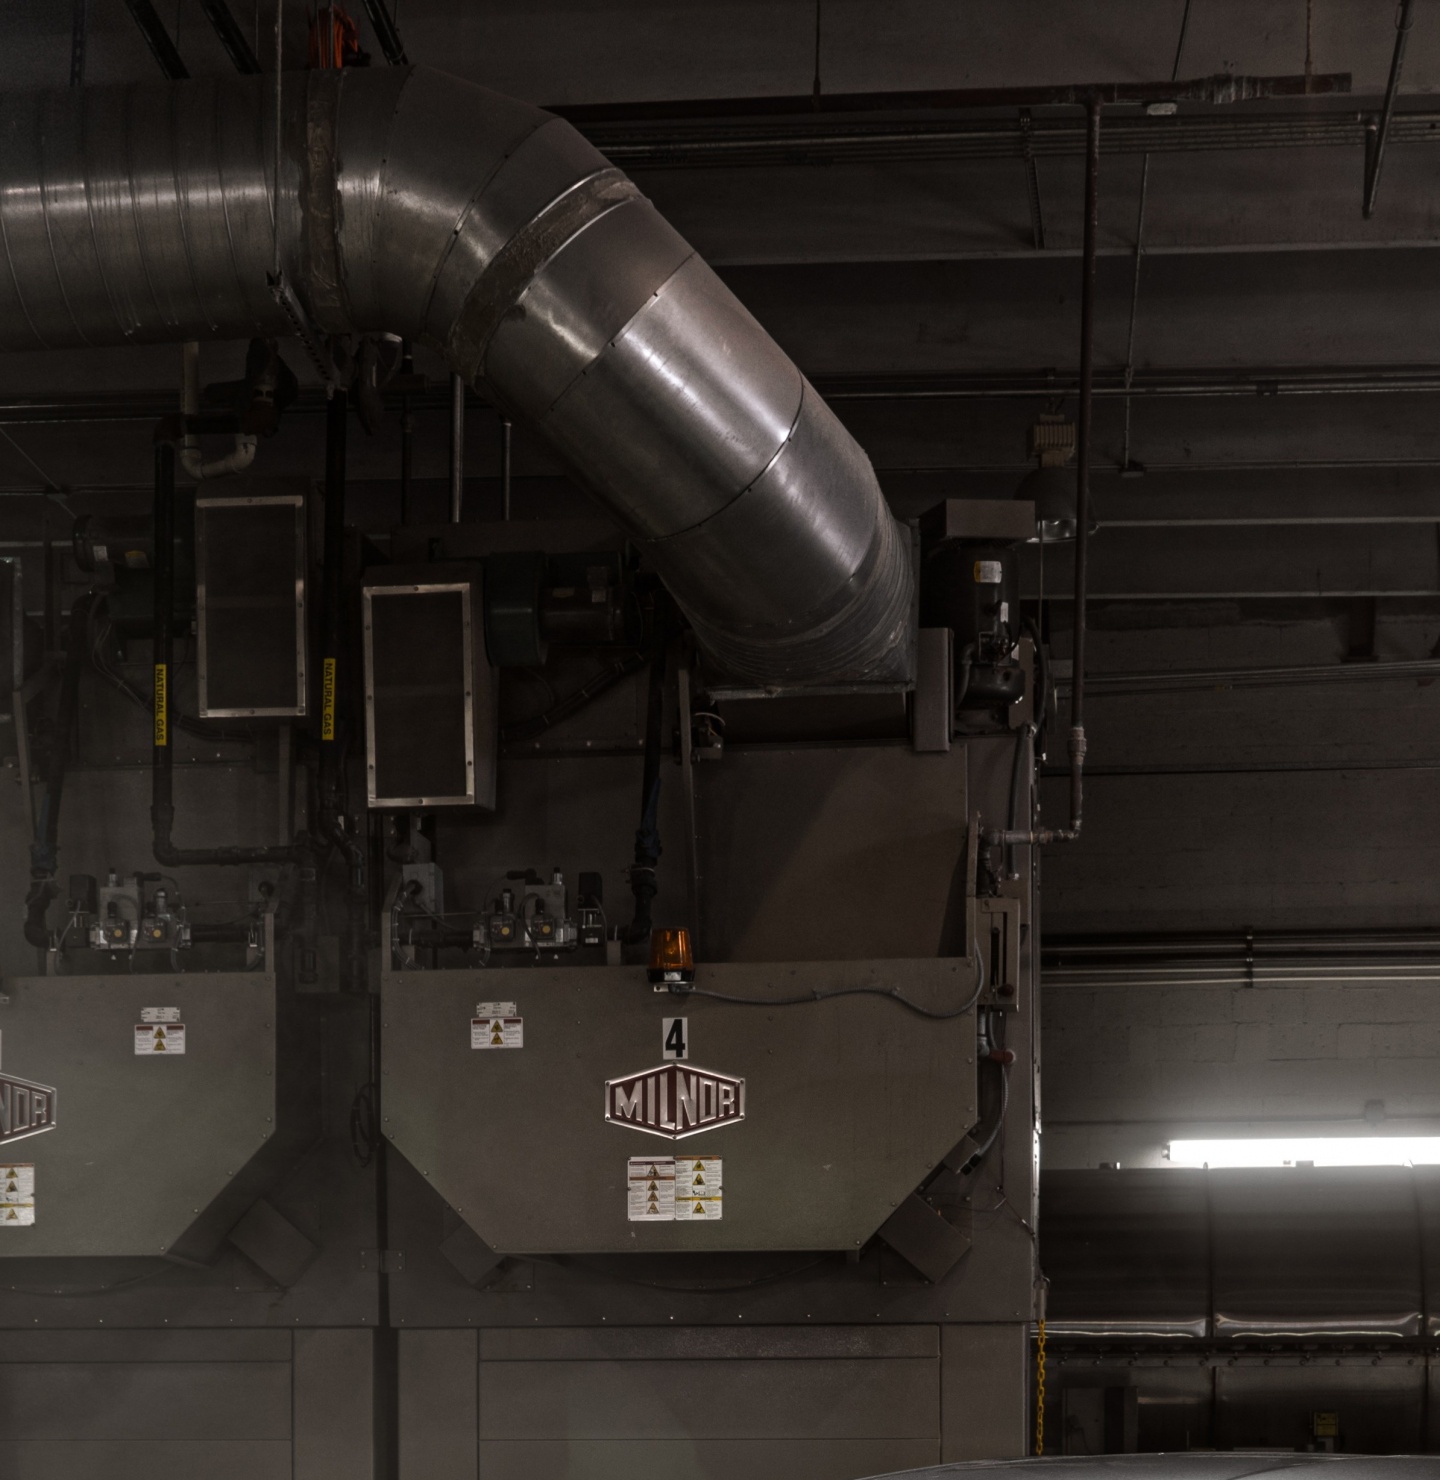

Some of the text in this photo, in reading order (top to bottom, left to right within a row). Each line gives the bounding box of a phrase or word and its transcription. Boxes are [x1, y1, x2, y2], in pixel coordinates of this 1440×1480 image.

[156, 668, 164, 741] NATURAL GAS
[323, 662, 333, 735] NATURAL GAS
[665, 1018, 686, 1058] 4
[614, 1069, 735, 1131] MILNOR
